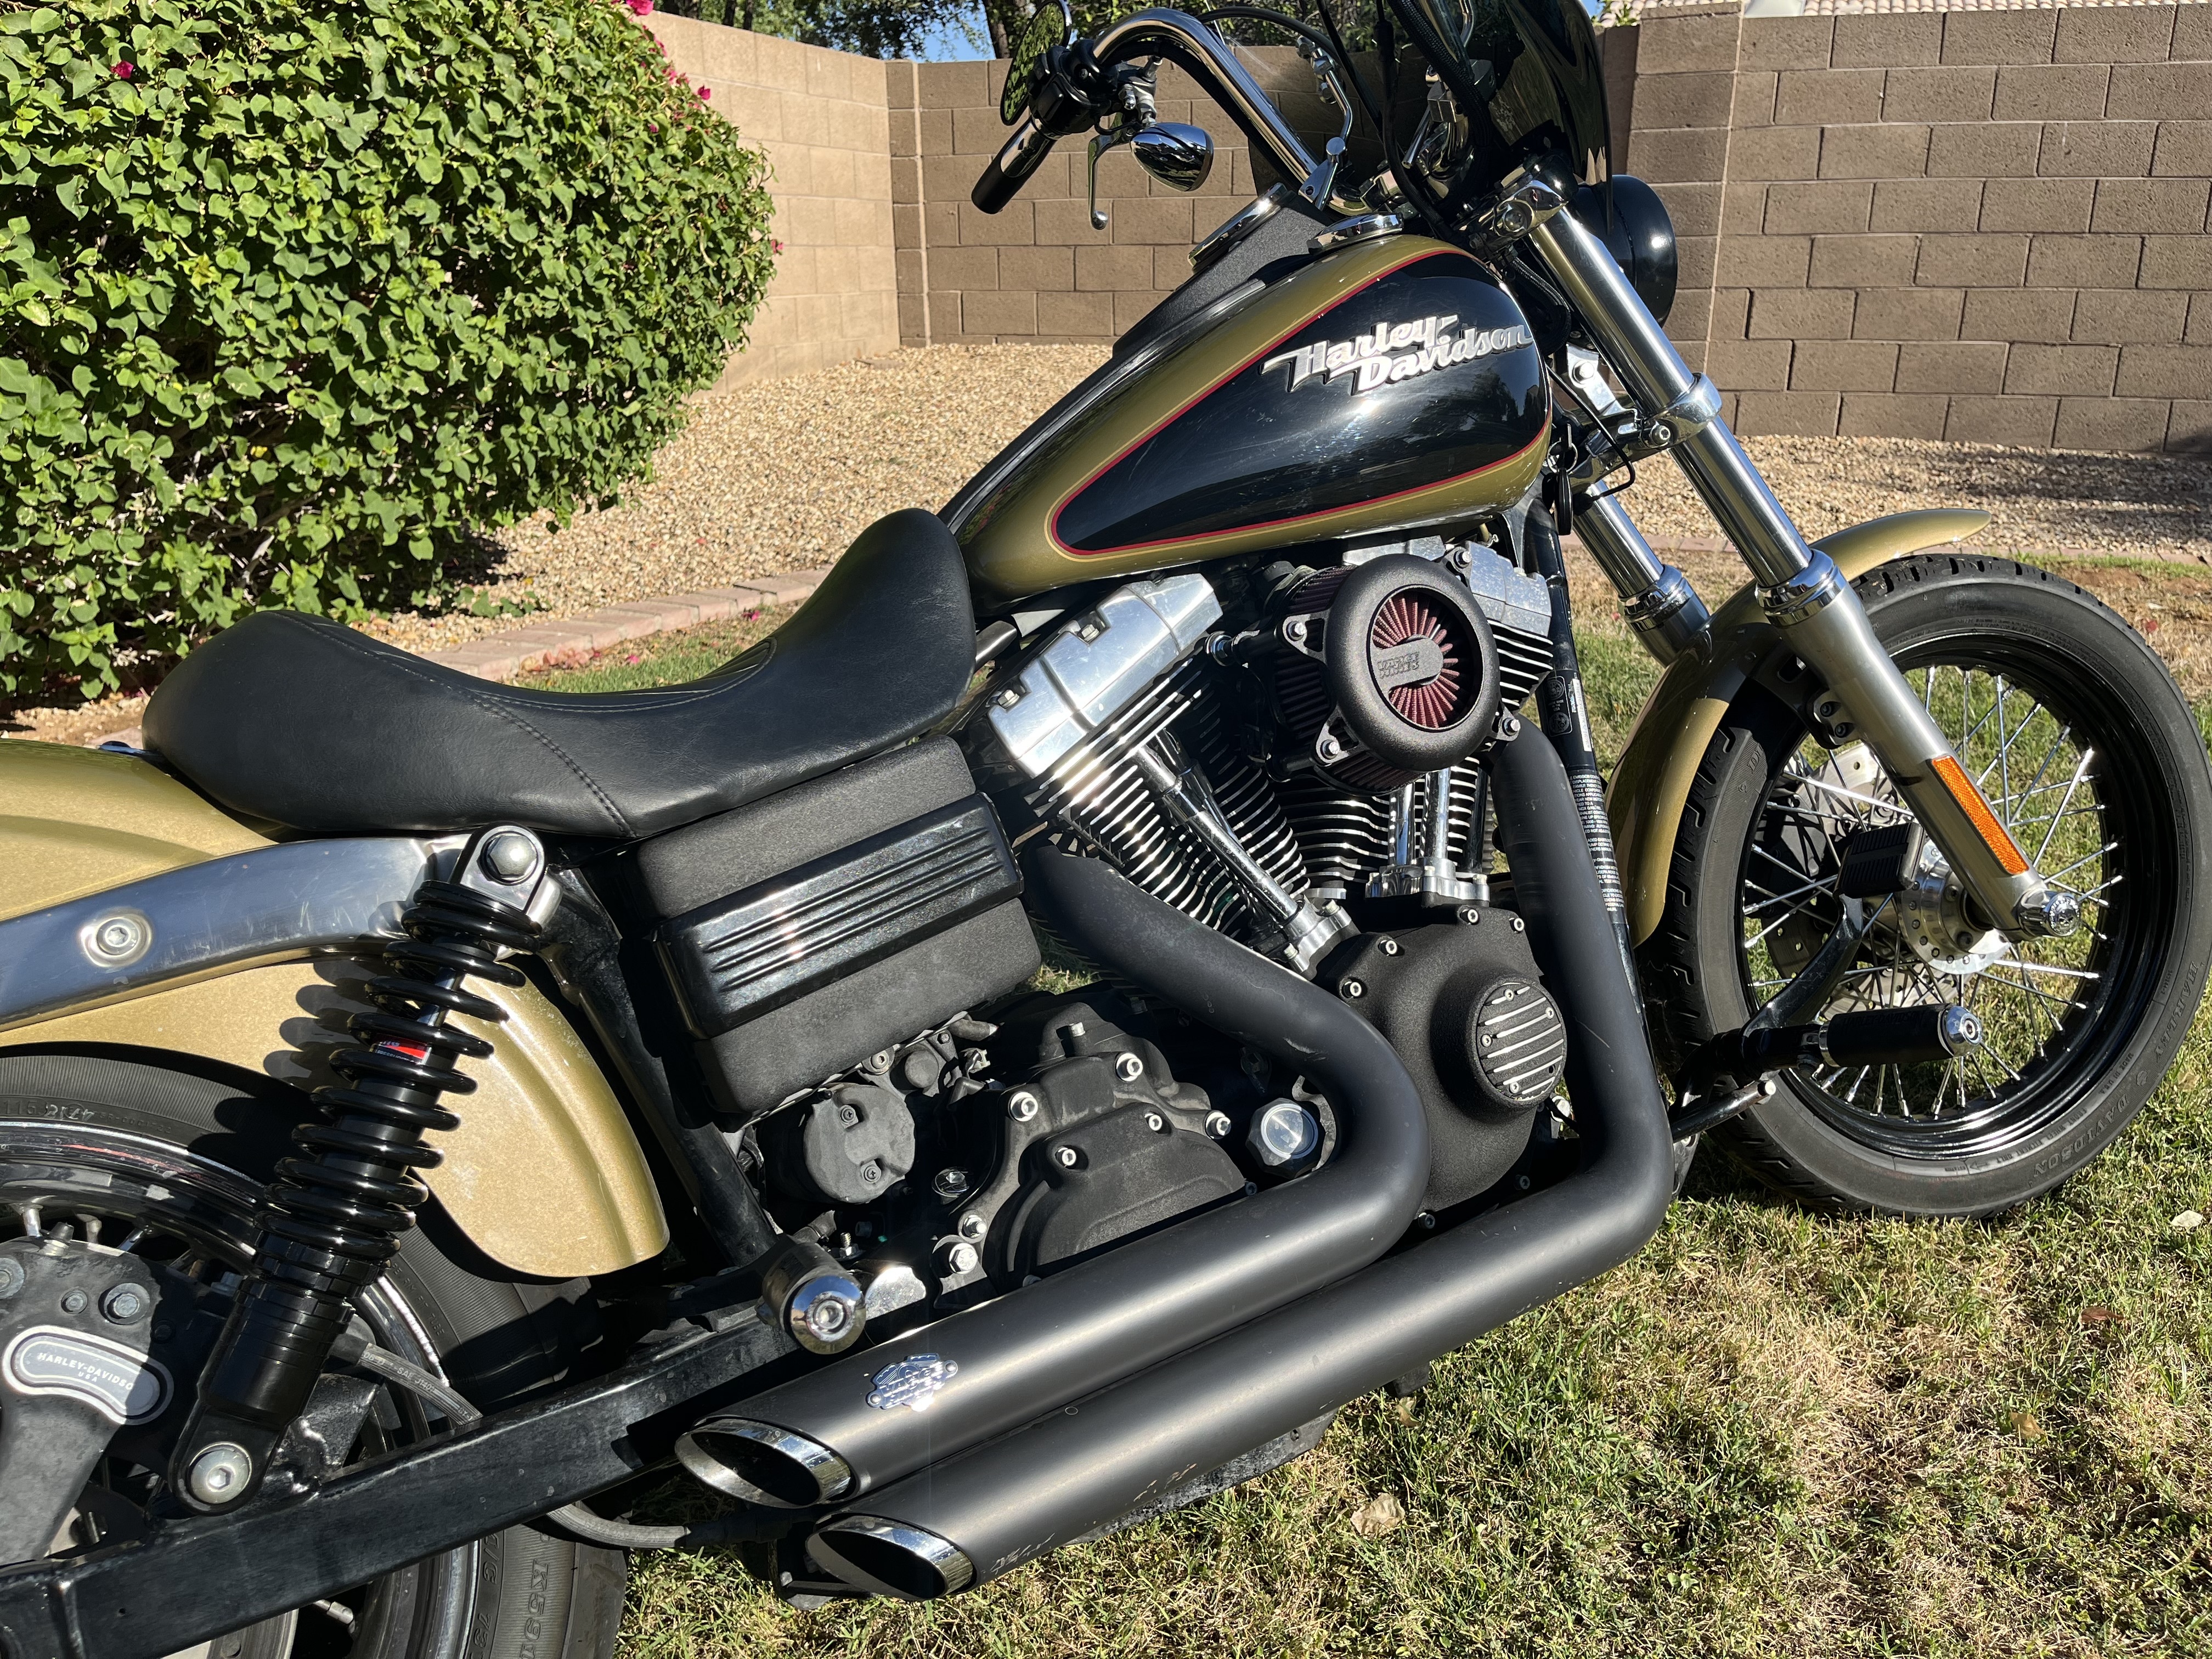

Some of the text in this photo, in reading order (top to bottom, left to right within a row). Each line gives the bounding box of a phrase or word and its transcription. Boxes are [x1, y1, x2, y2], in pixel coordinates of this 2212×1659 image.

[1323, 324, 1534, 396] Davidson
[2155, 961, 2198, 1063] HARLEY
[2033, 1096, 2130, 1177] DAVIDSON
[2046, 1124, 2066, 1141] WHEEL
[2067, 1107, 2088, 1126] FRONT
[37, 1352, 134, 1391] HARLEY-DAVIDSO
